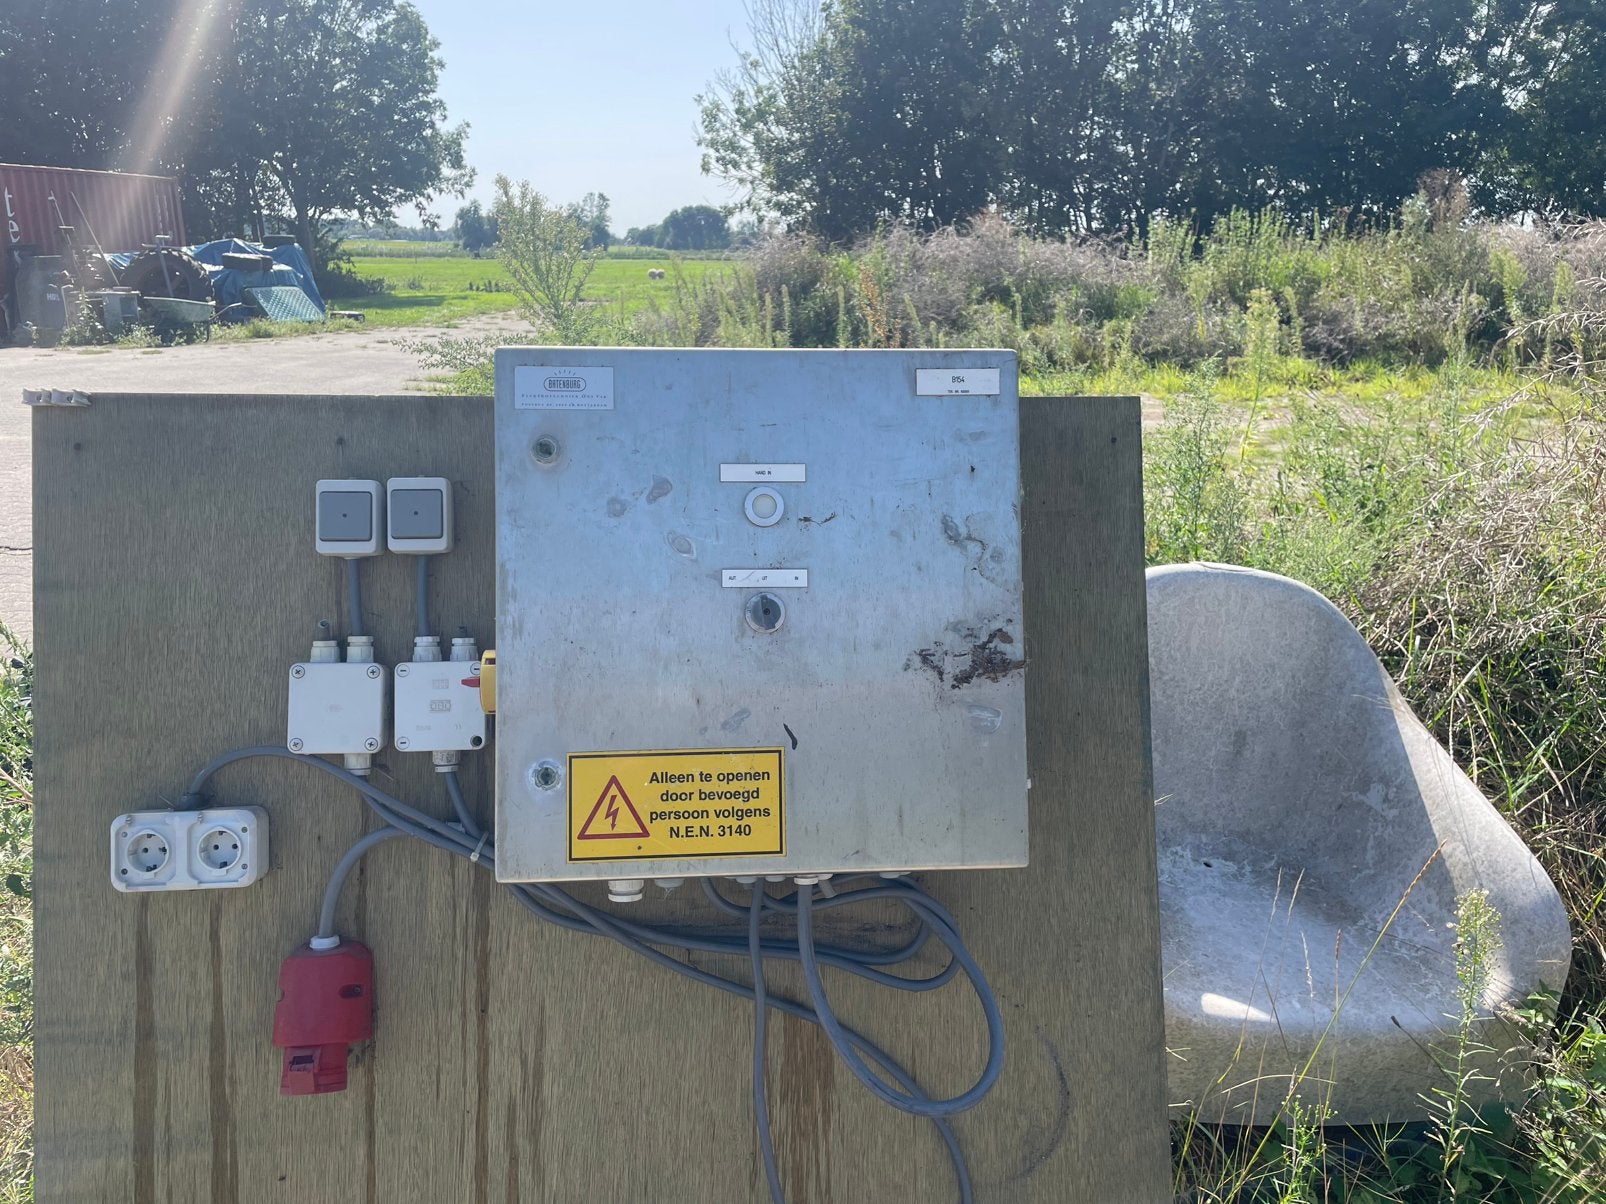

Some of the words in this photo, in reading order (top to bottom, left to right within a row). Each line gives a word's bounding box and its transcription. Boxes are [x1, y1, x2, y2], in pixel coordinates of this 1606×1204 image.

[548, 379, 581, 389] BATENBURG
[649, 771, 695, 784] Alleen
[699, 771, 713, 782] te
[717, 771, 770, 784] openen
[660, 790, 694, 802] door
[699, 788, 760, 802] bevoegd
[650, 809, 709, 824] persoon
[714, 806, 771, 820] volgens
[669, 825, 714, 838] N.E.N.
[718, 824, 752, 836] 3140
